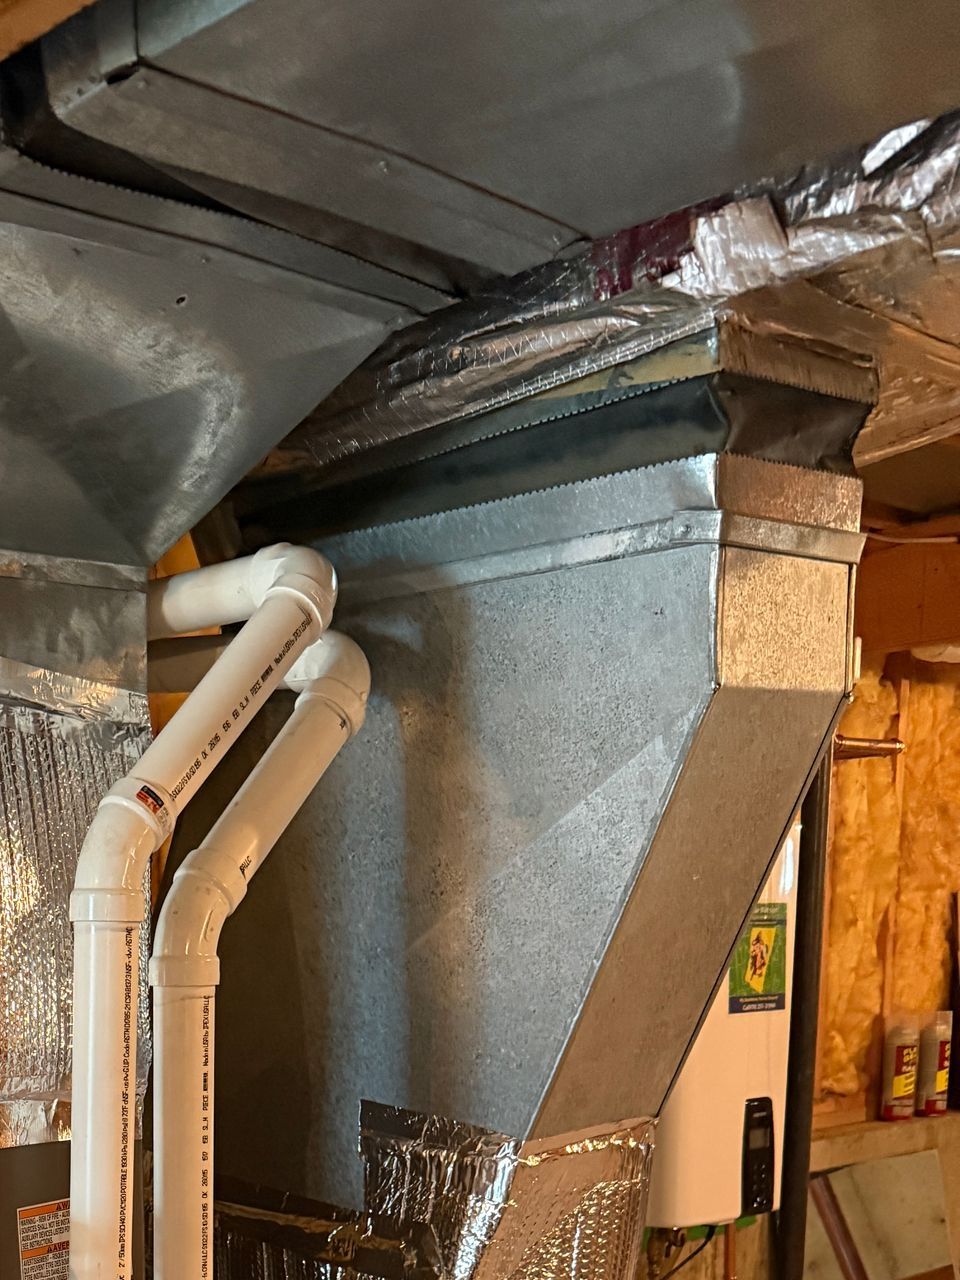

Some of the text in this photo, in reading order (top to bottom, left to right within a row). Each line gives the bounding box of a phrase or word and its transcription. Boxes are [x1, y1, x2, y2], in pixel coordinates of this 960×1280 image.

[123, 1044, 131, 1058] Code
[120, 1169, 128, 1194] POTABLE
[202, 1191, 209, 1199] OK
[21, 1225, 36, 1234] SOURCES
[53, 1241, 69, 1251] AVER
